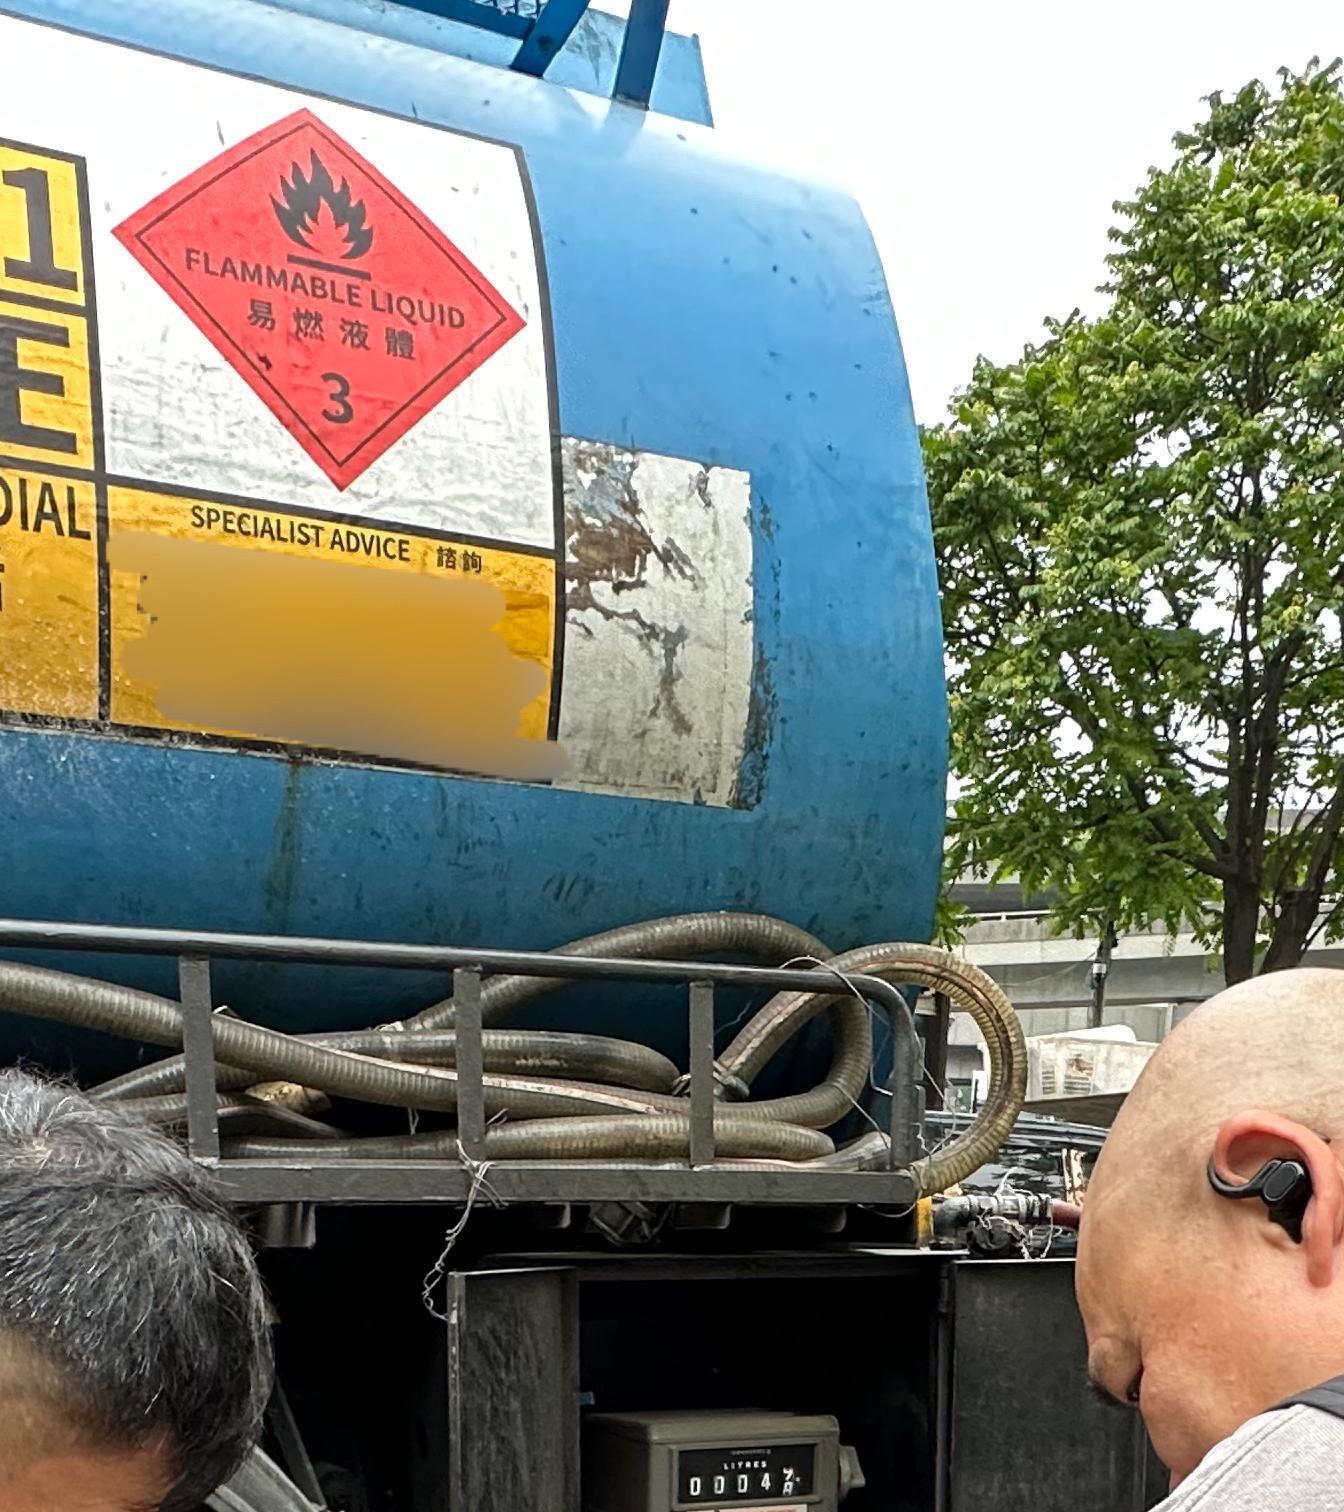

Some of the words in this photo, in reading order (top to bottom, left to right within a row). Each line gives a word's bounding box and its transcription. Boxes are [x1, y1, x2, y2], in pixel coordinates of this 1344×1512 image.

[185, 247, 363, 307] FLAMMABLE
[370, 289, 465, 329] LIQUID
[247, 298, 416, 361] 易燃液體
[321, 372, 354, 424] 3
[191, 505, 325, 549] SPECIALIST
[330, 528, 410, 562] ADVICE
